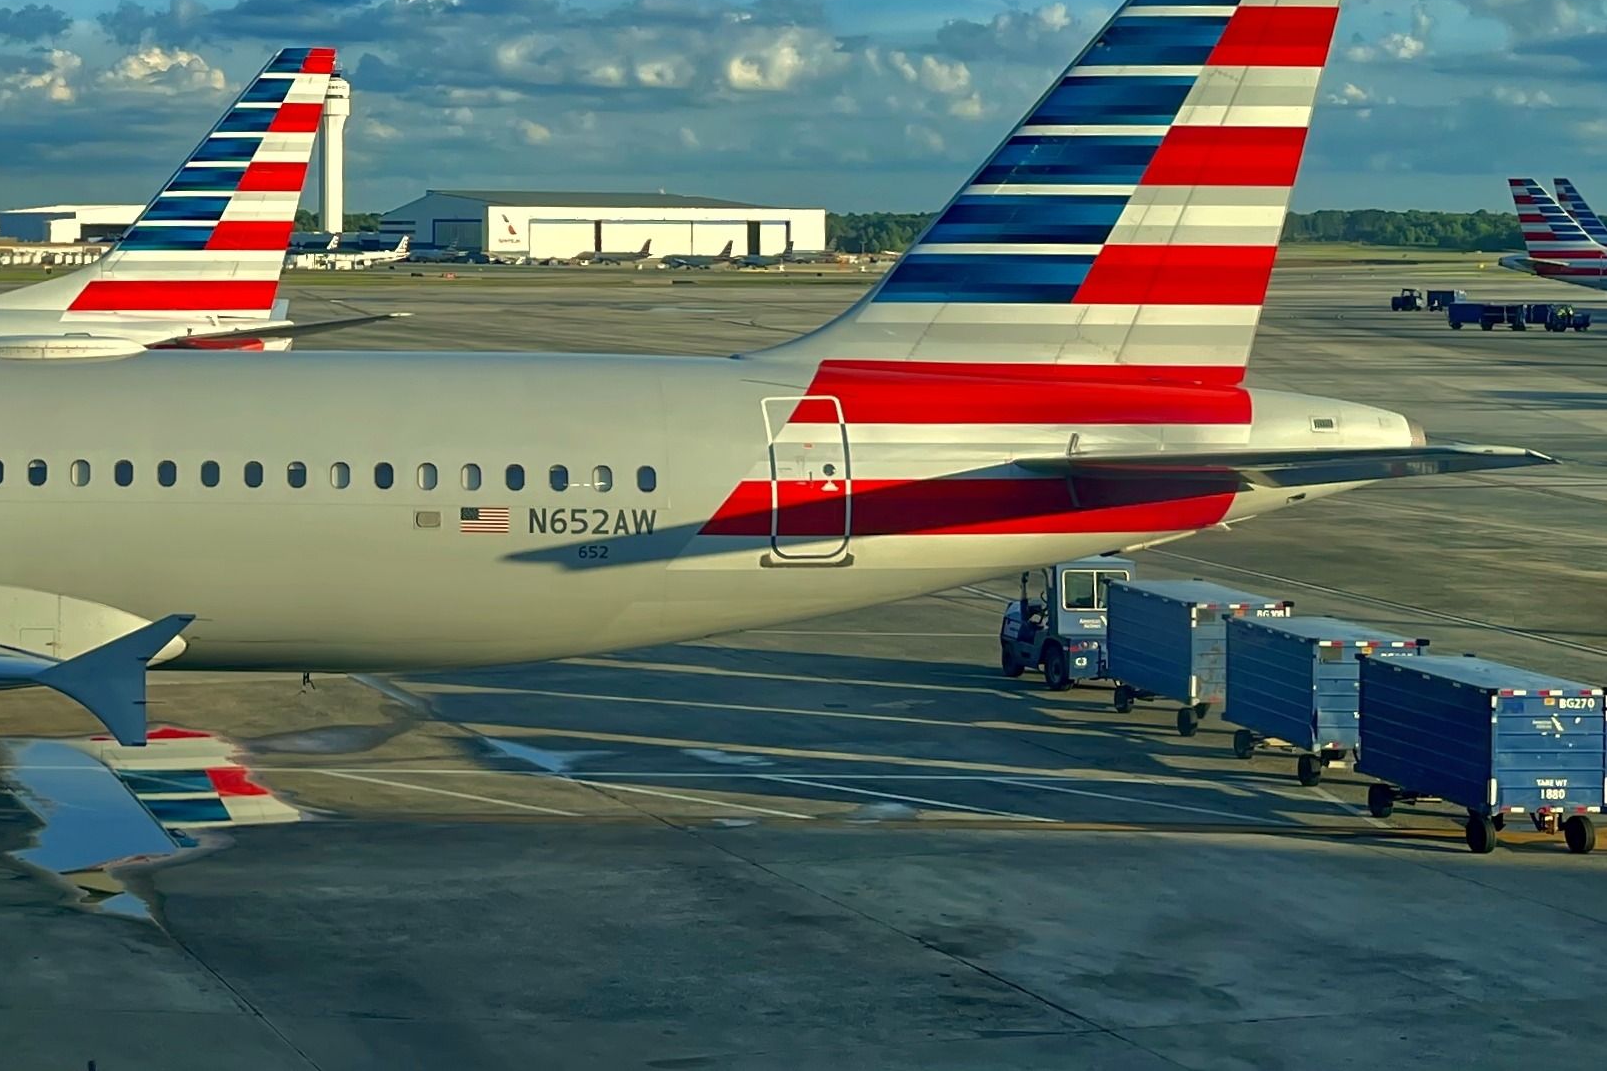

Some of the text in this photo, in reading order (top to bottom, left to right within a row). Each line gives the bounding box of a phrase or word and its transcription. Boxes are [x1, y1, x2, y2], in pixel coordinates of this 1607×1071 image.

[529, 508, 656, 535] N652AW
[578, 545, 609, 559] 652
[1075, 657, 1088, 666] C3
[1559, 698, 1595, 709] BG270
[1555, 779, 1567, 787] WT
[1540, 789, 1566, 799] 1880
